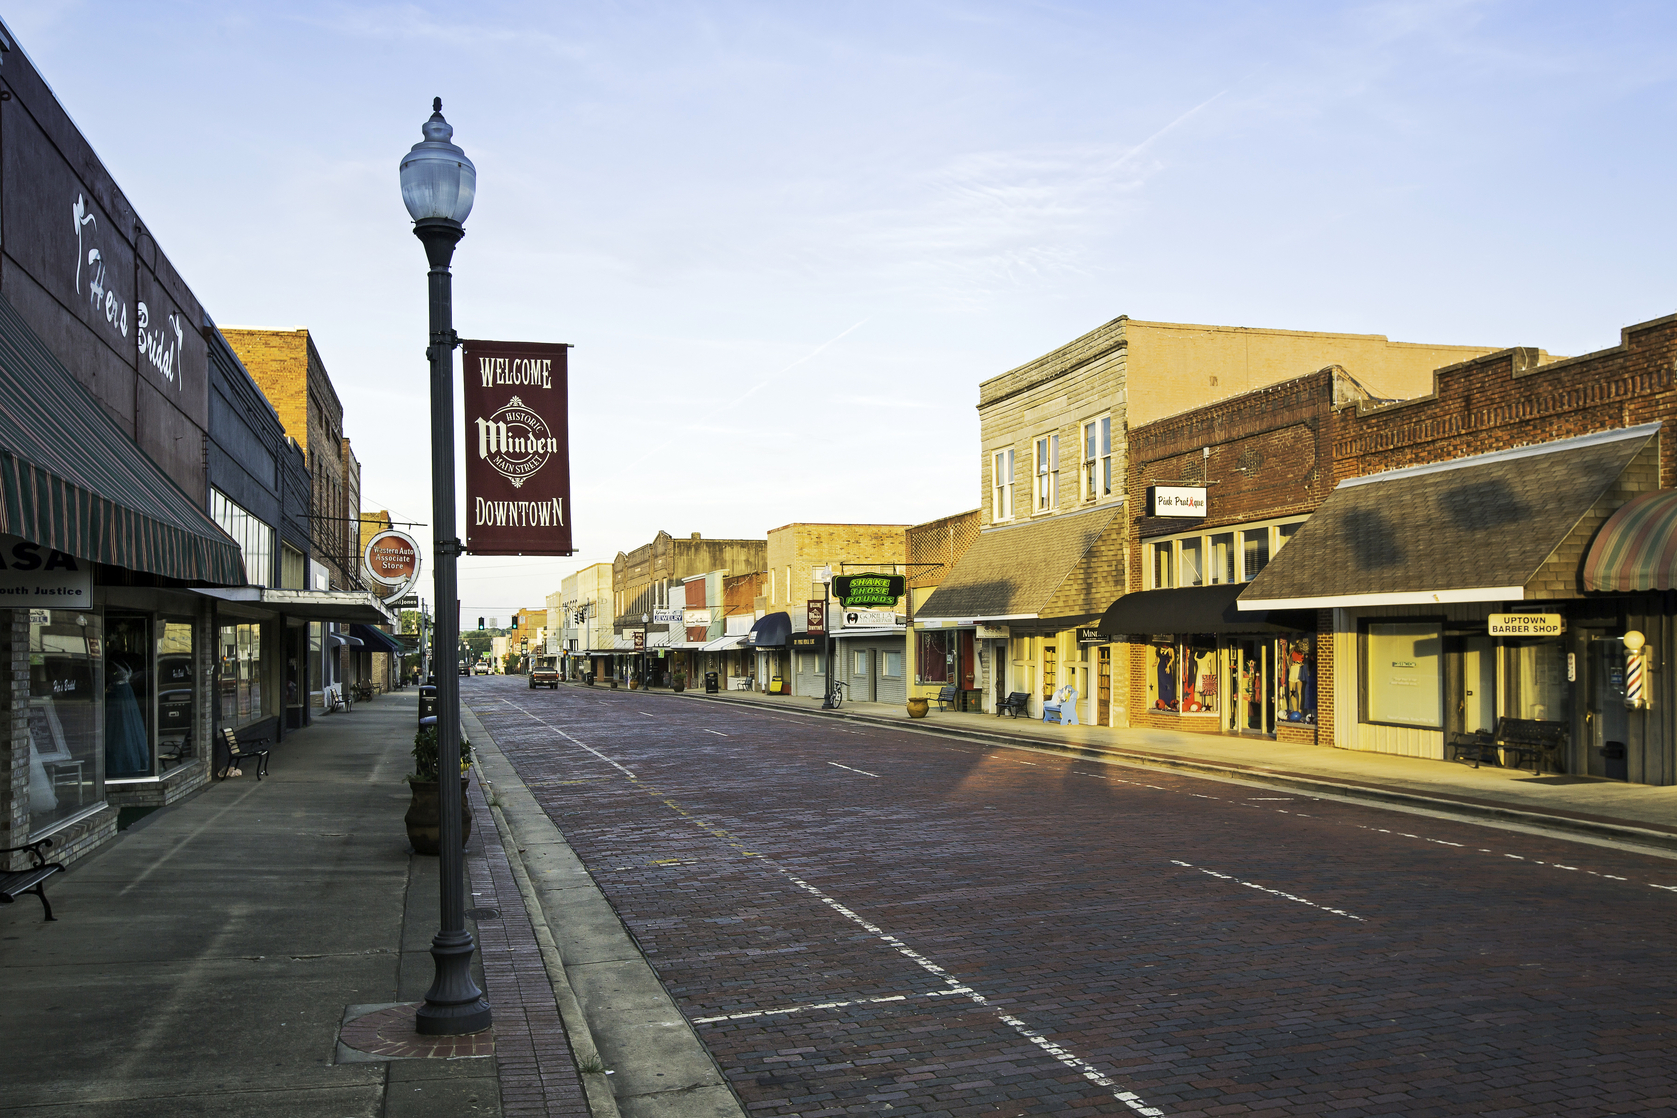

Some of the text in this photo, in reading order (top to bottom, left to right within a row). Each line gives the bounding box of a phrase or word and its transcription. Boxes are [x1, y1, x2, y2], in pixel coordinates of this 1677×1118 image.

[138, 302, 174, 383] Bridal
[479, 357, 552, 389] WELCOME
[505, 412, 544, 433] HISTORIC
[474, 416, 558, 460] Minden
[493, 455, 543, 474] MAIN STREET
[1158, 496, 1173, 506] Pink
[475, 496, 564, 527] DOWNTOWN
[374, 546, 414, 555] Western Auto
[375, 554, 411, 563] Associate
[849, 578, 891, 587] SHAKE
[34, 587, 83, 596] Justice
[851, 587, 889, 596] THOSE
[847, 596, 894, 604] POUNDS
[1533, 625, 1558, 633] SHOP
